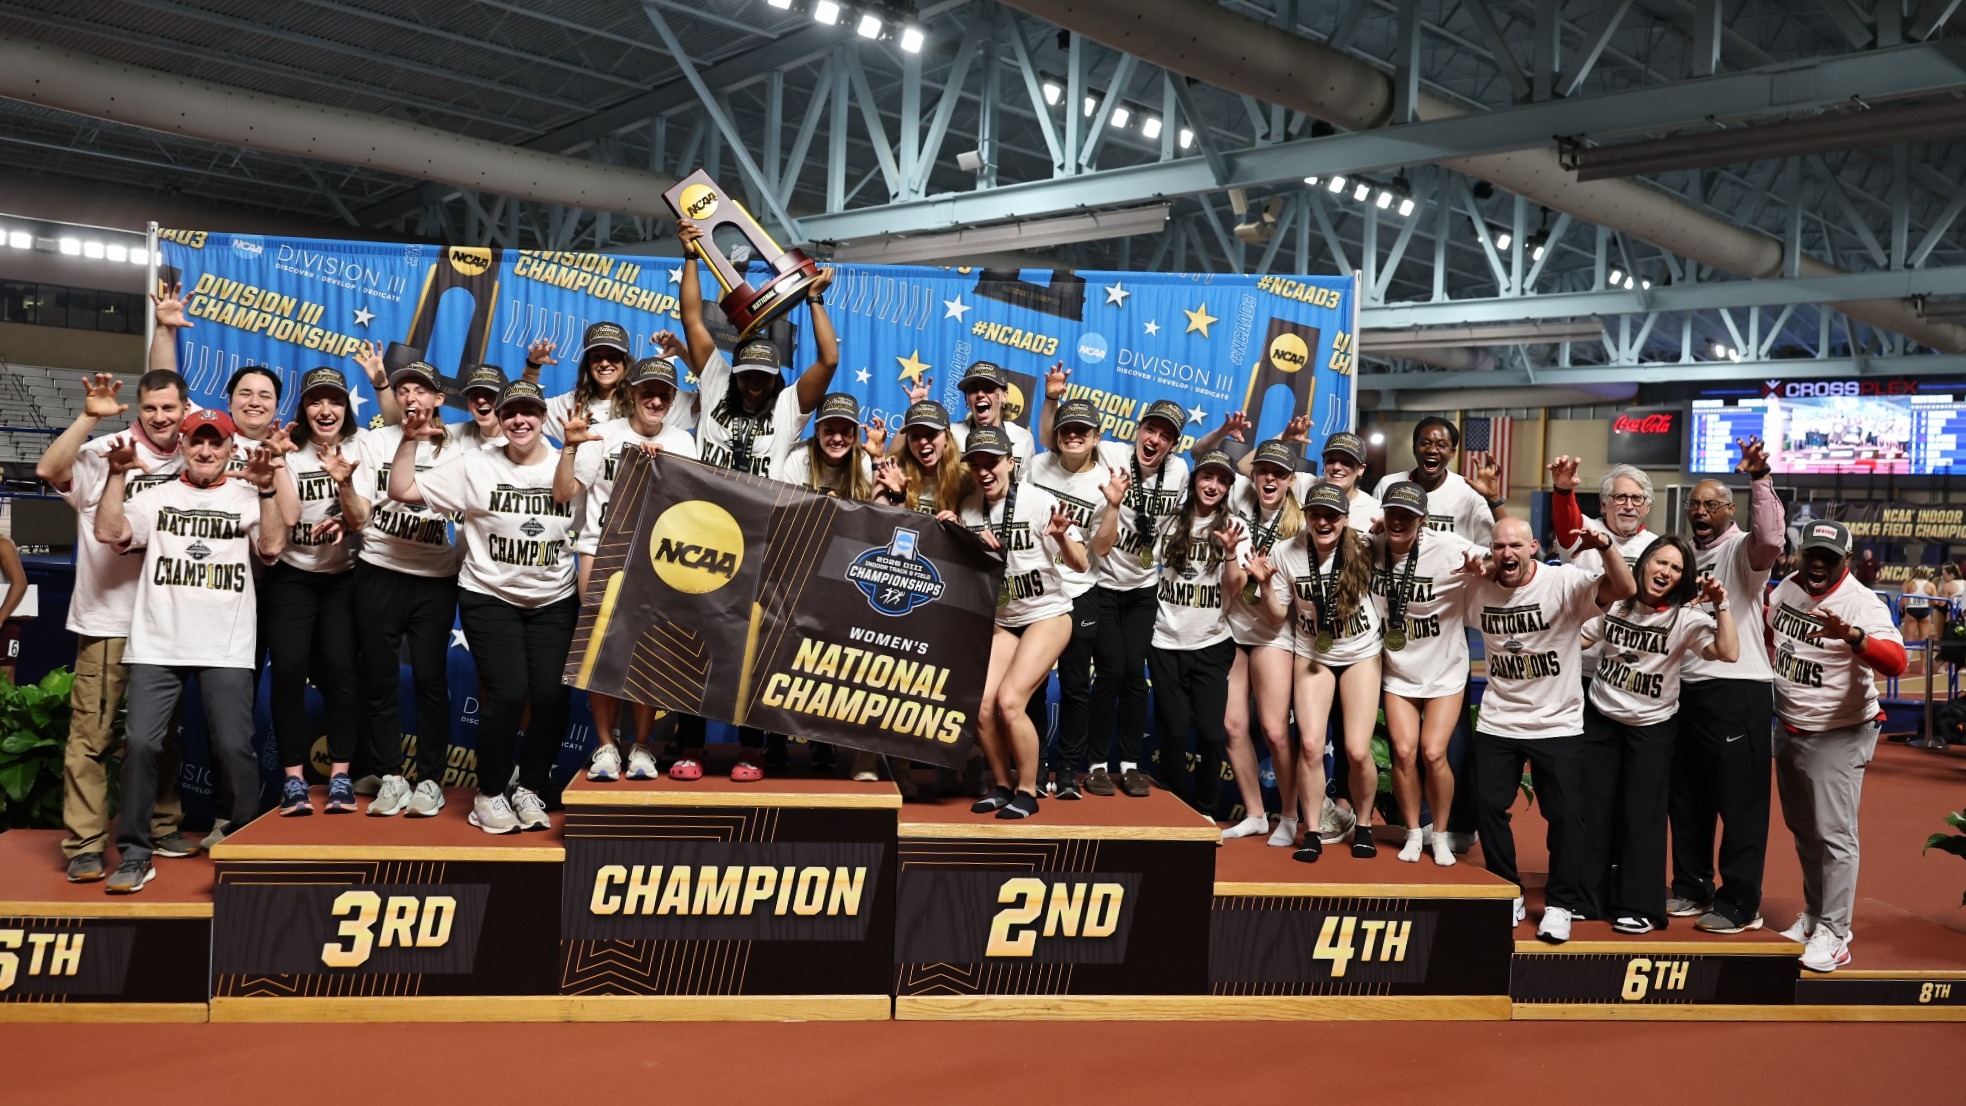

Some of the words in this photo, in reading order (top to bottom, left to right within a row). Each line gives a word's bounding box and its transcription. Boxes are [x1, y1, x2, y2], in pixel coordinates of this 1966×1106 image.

[687, 191, 718, 218] NCAA
[232, 238, 264, 254] NCAA
[452, 251, 489, 269] NCAA
[278, 245, 380, 287] DIVISION
[194, 272, 298, 318] DIVISION
[275, 263, 315, 279] DISCOVER
[321, 275, 356, 290] DEVELOP
[363, 287, 401, 302] DEDICATE
[1256, 275, 1342, 310] #NCAAD3
[752, 288, 776, 312] NATIONAL
[971, 320, 1058, 357] #NCAAD3
[1079, 345, 1106, 360] NCAA
[1118, 348, 1210, 385] DIVISION
[1273, 349, 1305, 366] NCAA
[1116, 366, 1151, 380] DISCOVER
[1157, 377, 1189, 390] DEVELOP
[1195, 387, 1229, 400] DEDICATE
[157, 510, 245, 539] NATIONAL
[1882, 523, 1913, 537] FIELD
[1883, 509, 1914, 522] NCAA
[1917, 509, 1963, 523] INDOOR
[154, 556, 245, 593] CHAMP1ONS
[655, 538, 738, 579] NCAA
[865, 560, 888, 571] INDOOR
[889, 565, 908, 575] TRACK
[914, 572, 931, 580] FIELD
[876, 556, 901, 566] 2026
[849, 565, 942, 596] CHAMPIONSHIPS
[1480, 611, 1550, 635] NATIONAL
[11, 641, 18, 656] 6
[849, 626, 929, 655] WOMEN'S
[792, 638, 951, 701] NATIONAL
[762, 673, 966, 744] CHAMPIONS
[590, 865, 867, 916] CHAMPION
[321, 890, 457, 967] 3RD
[985, 877, 1124, 957] 2ND
[1312, 916, 1412, 977] 4TH
[1621, 959, 1690, 1001] 6TH
[1919, 982, 1952, 1004] 8TH
